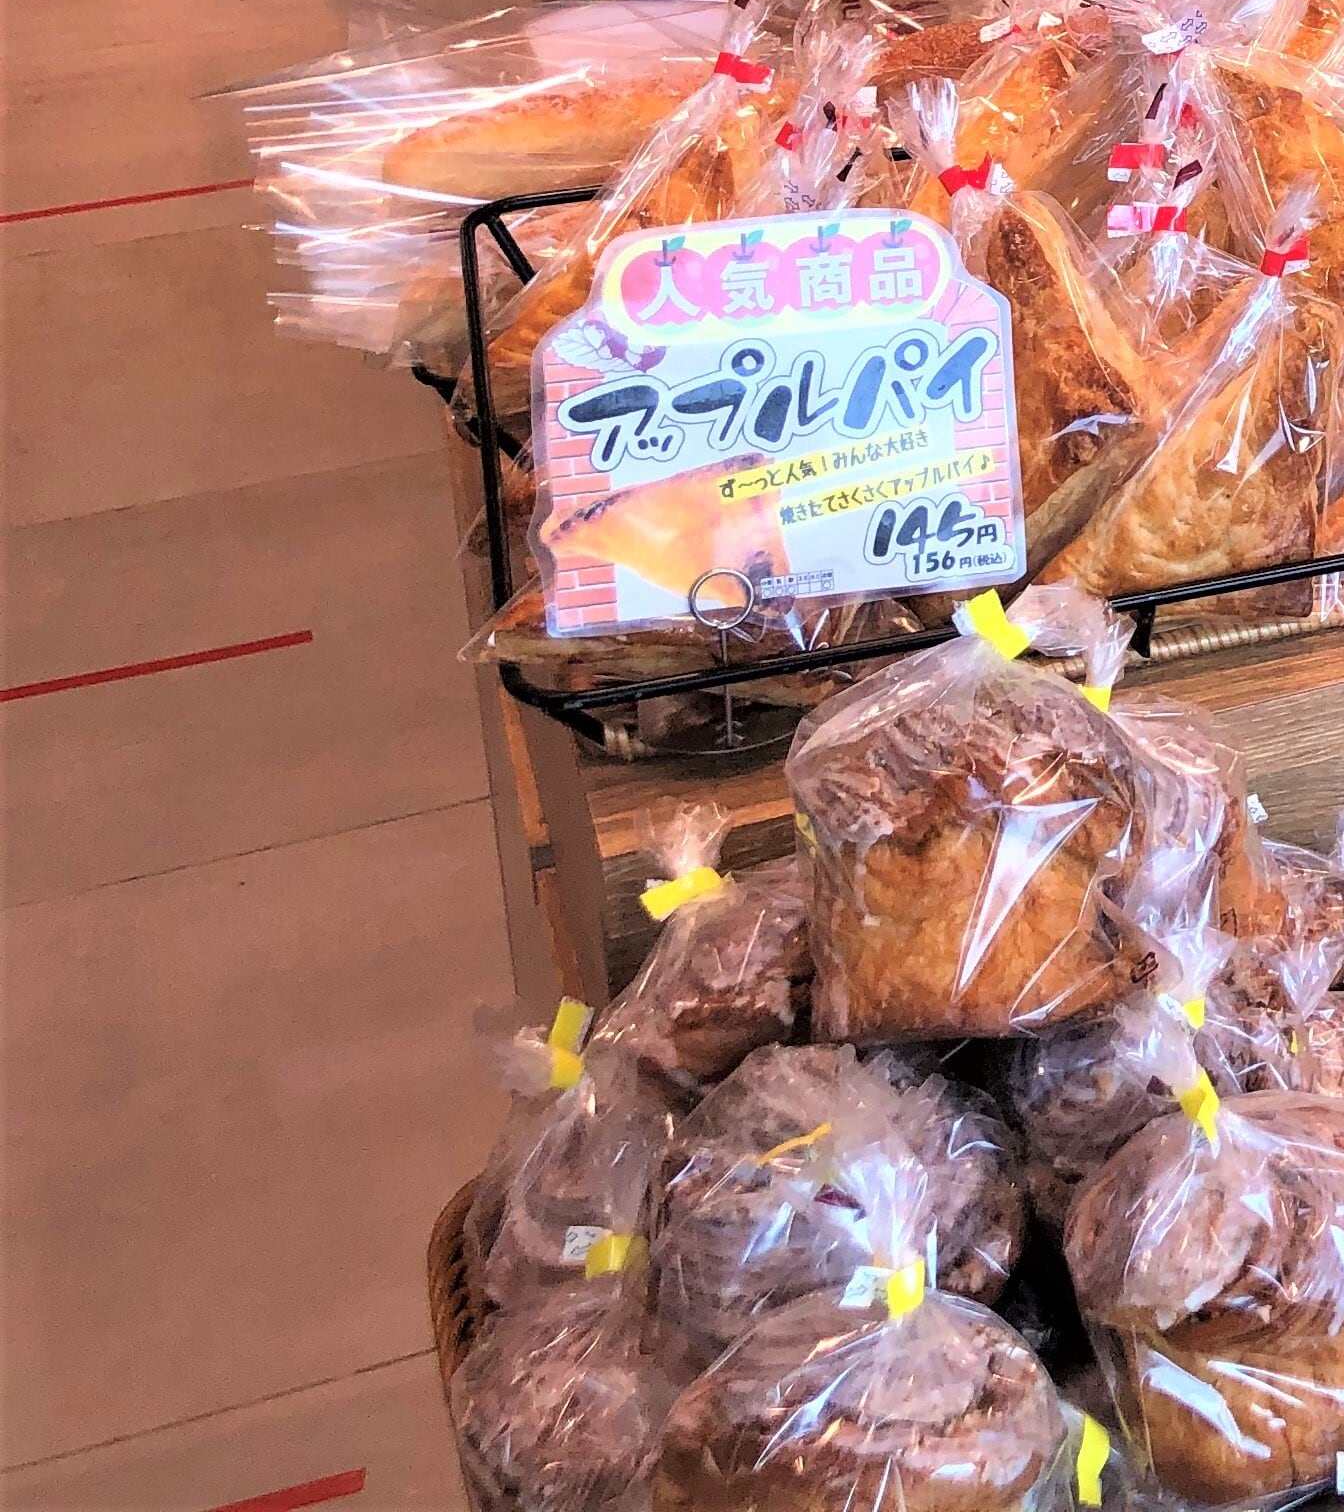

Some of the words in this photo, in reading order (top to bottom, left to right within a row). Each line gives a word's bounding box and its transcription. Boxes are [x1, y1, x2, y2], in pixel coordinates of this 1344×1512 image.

[637, 246, 924, 320] 人気商品
[567, 335, 990, 464] アップルパイ
[871, 497, 999, 559] 145円
